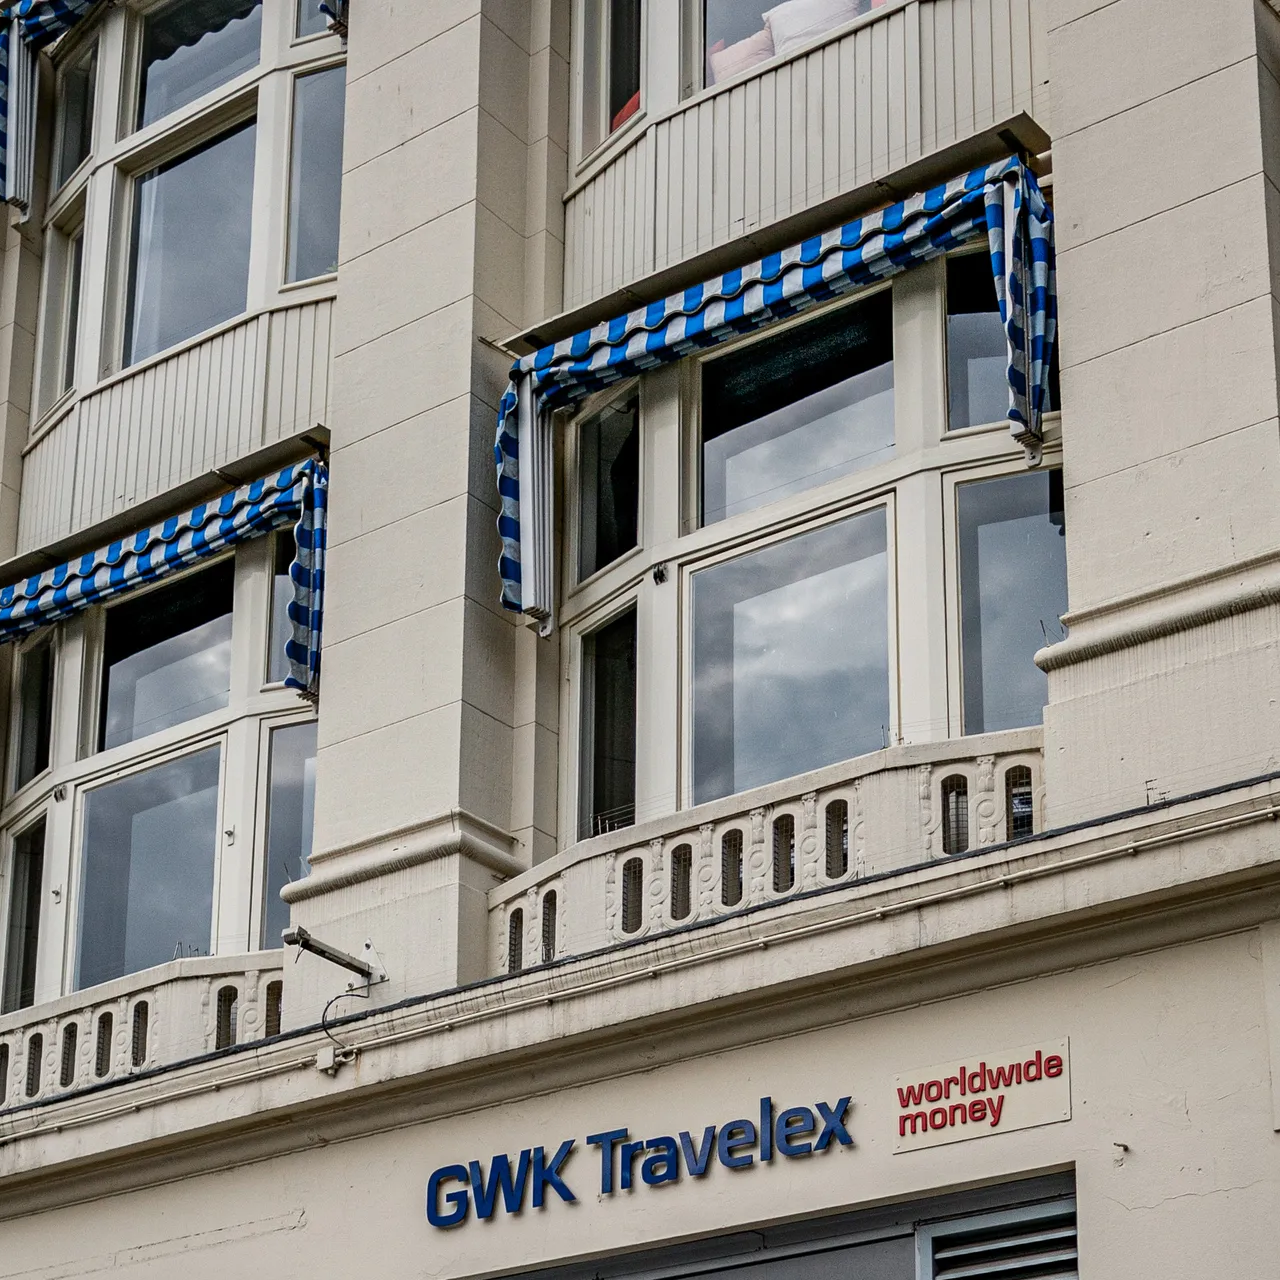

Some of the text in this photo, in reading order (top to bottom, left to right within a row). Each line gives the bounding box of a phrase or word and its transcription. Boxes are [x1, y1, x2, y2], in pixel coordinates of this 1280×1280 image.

[897, 1050, 1063, 1107] worldwide
[899, 1094, 1004, 1137] money
[426, 1096, 853, 1228] GWK Travelex
